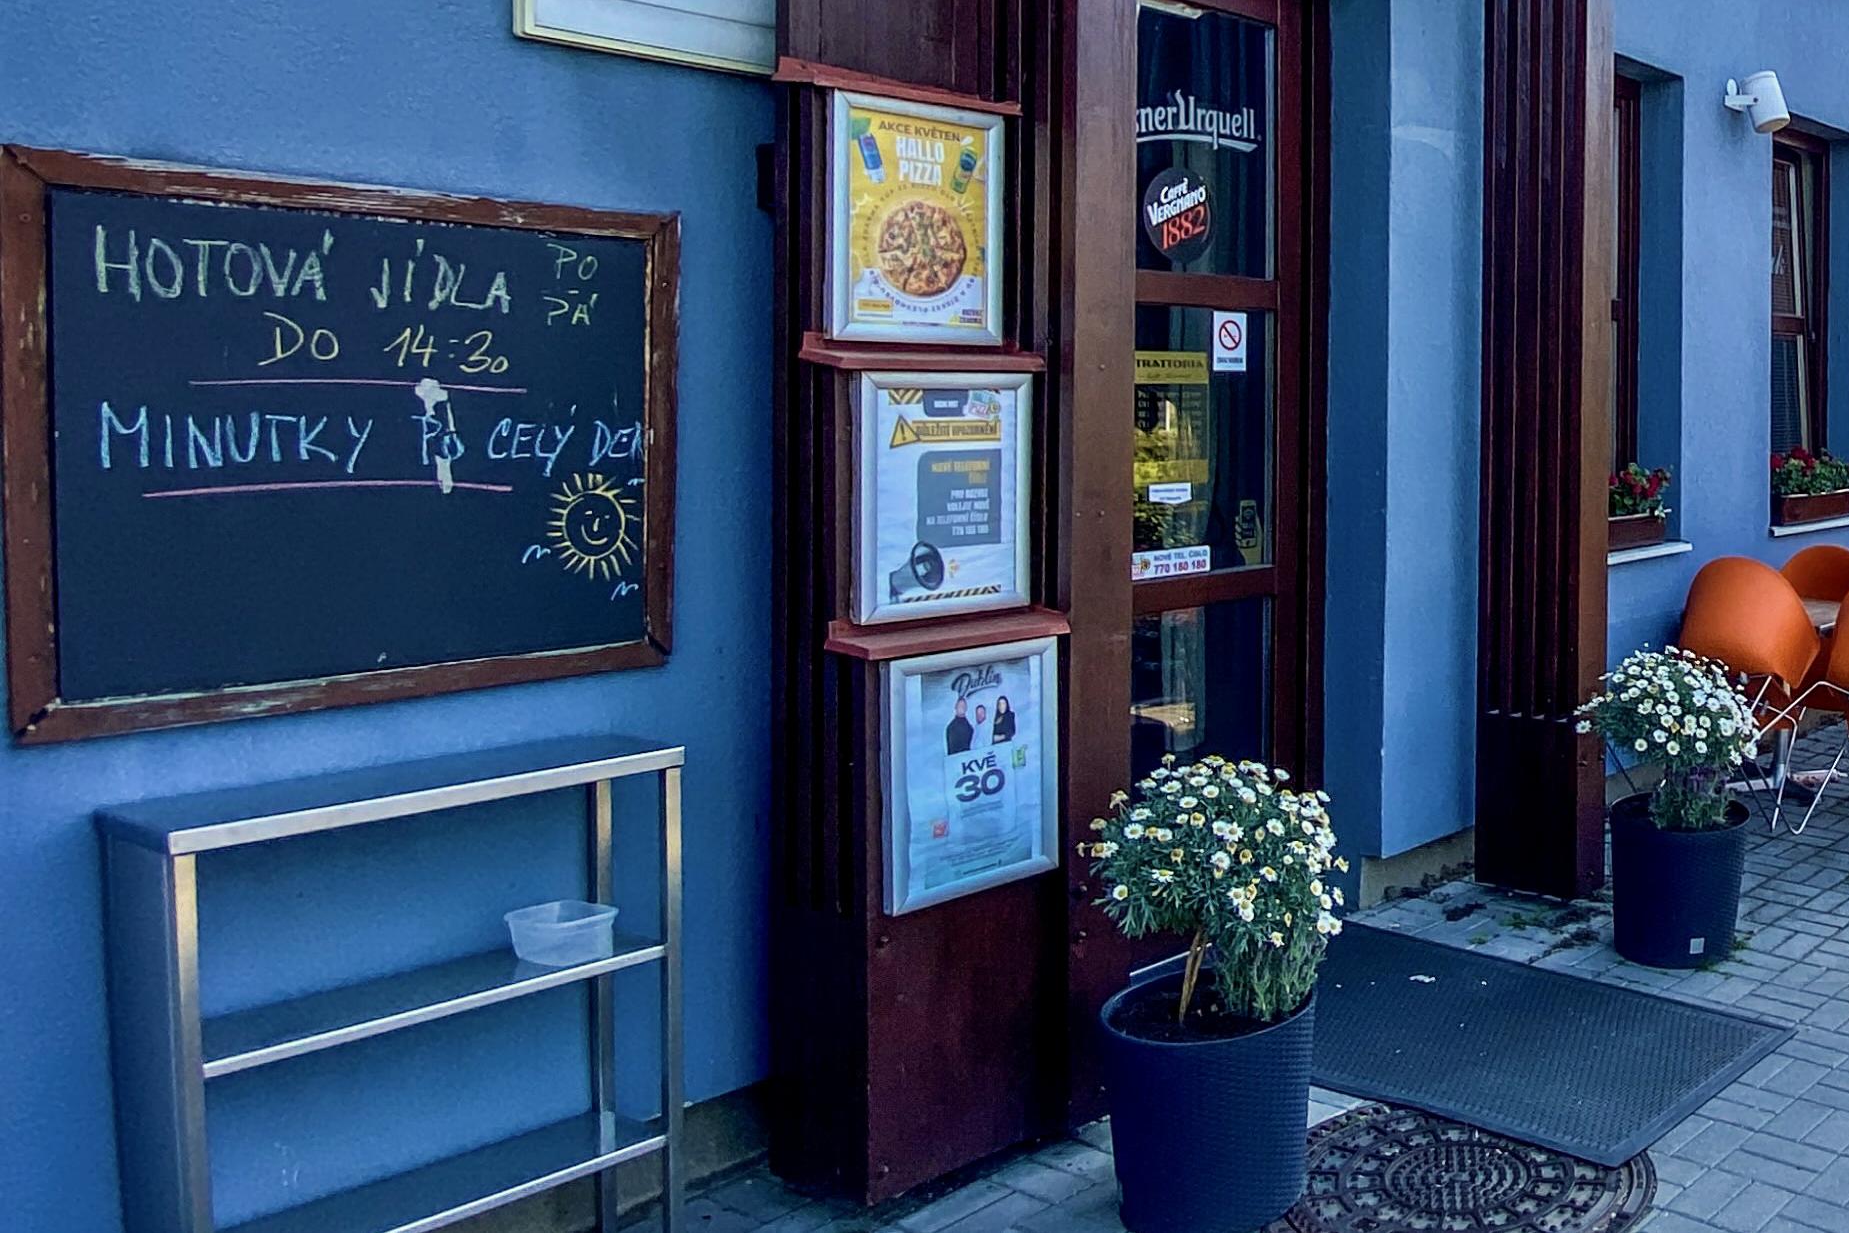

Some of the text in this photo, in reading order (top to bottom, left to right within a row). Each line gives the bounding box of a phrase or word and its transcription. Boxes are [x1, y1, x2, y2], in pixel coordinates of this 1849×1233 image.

[878, 120, 961, 142] AKCE KVĚTEN
[1174, 88, 1255, 150] Urquell
[896, 135, 945, 164] HALLO
[899, 160, 942, 186] PIZZA
[1146, 185, 1207, 227] VERGNANO
[1163, 205, 1206, 250] 1882
[95, 224, 512, 313] HOTOVÁ JÍDLA
[546, 243, 598, 280] PO
[258, 311, 509, 374] DO 14:30
[99, 400, 374, 473] MINUTKY
[487, 404, 576, 478] CELÝ
[962, 752, 997, 774] KVĚ
[954, 768, 1005, 802] 30
